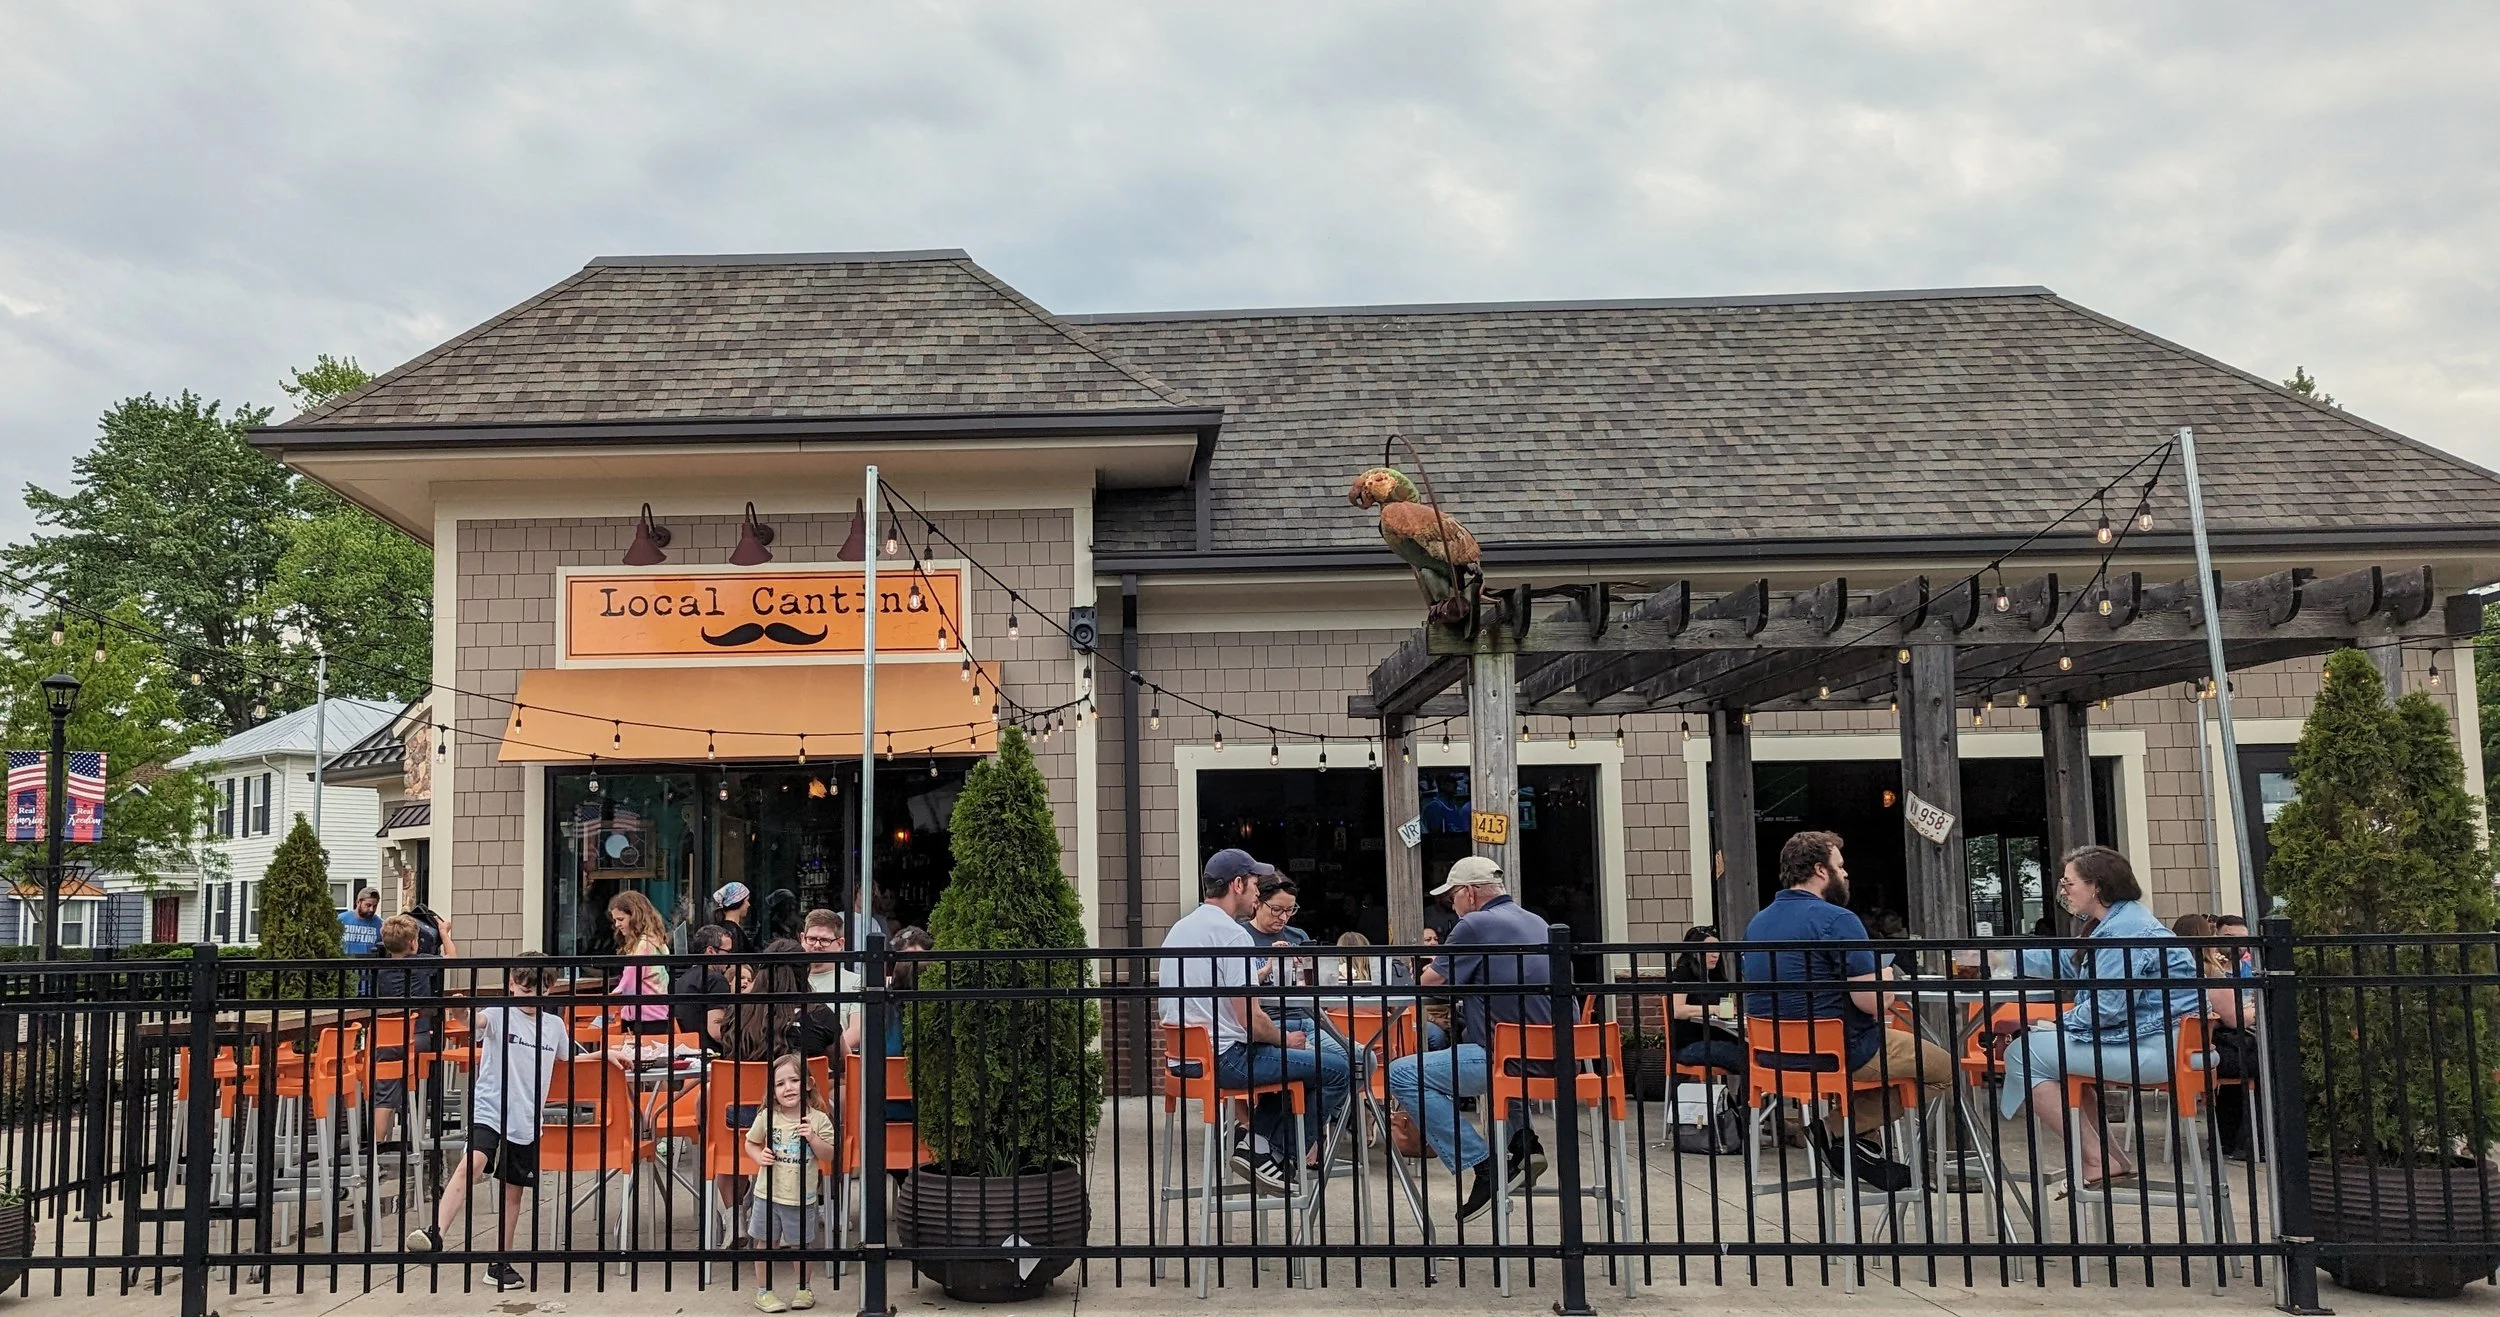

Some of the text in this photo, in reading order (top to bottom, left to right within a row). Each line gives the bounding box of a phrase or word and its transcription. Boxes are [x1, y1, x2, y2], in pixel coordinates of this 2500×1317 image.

[600, 587, 725, 617] Local
[76, 807, 94, 815] Real
[67, 813, 102, 826] Freedom
[1401, 819, 1420, 840] VR
[508, 1033, 555, 1052] Chamion
[773, 1155, 791, 1164] ANCE
